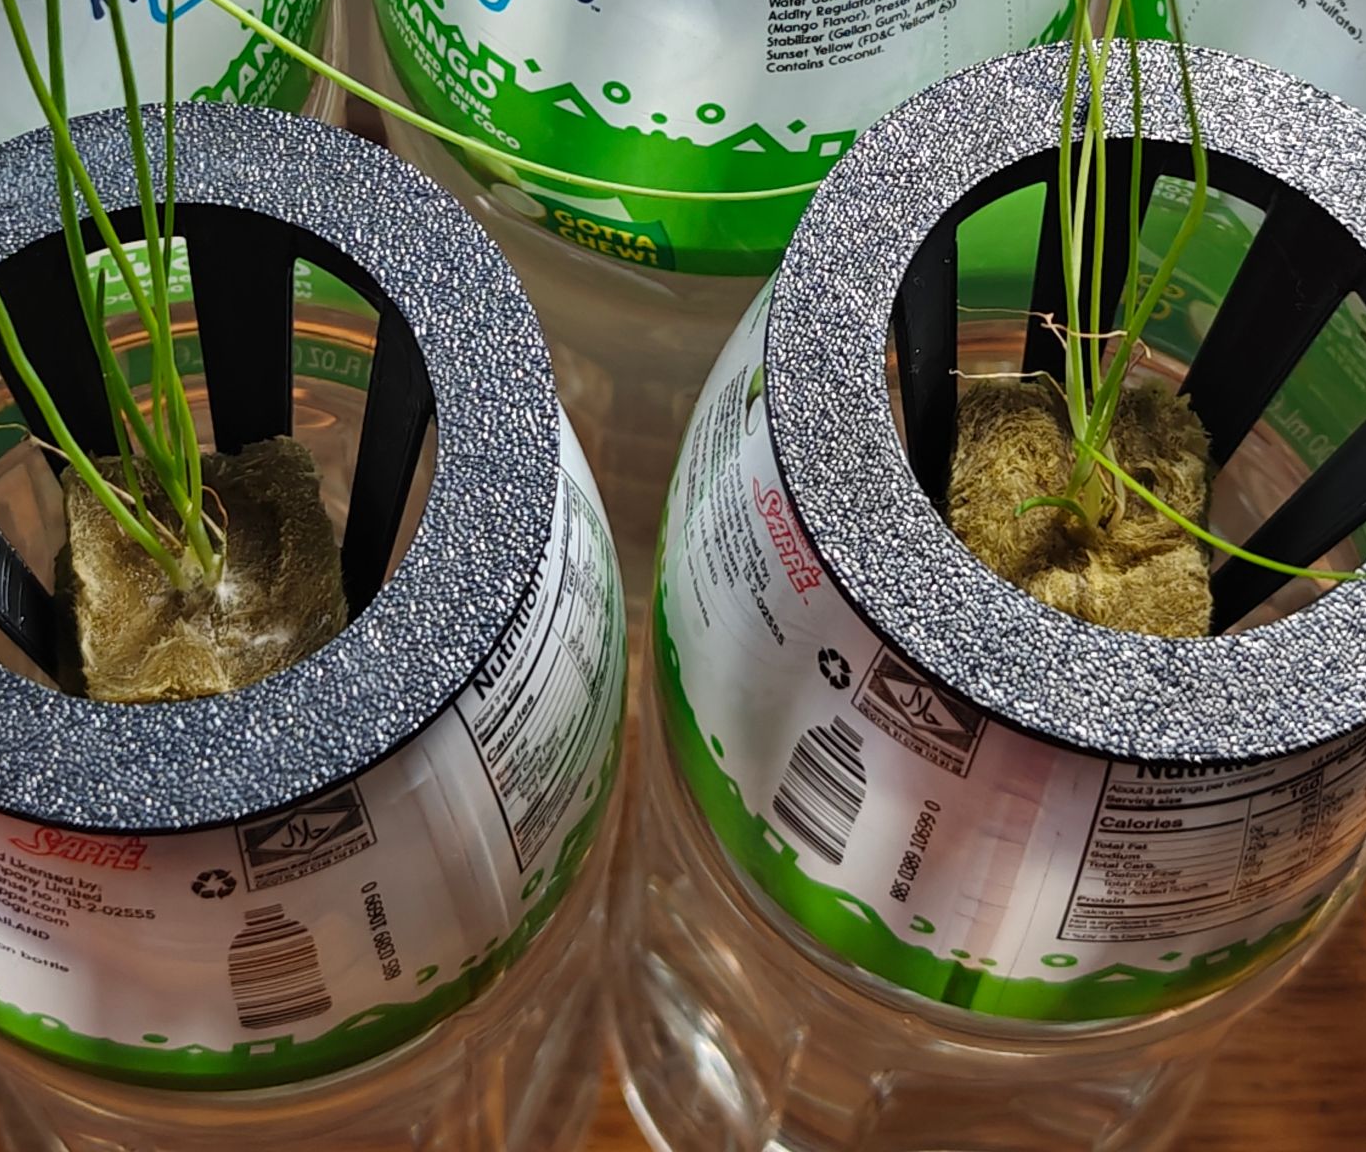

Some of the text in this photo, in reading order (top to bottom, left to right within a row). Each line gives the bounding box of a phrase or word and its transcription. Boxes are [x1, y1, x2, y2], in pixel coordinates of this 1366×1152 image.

[766, 49, 810, 61] Sunset
[813, 39, 854, 56] Yellow
[899, 11, 935, 32] Yellow
[767, 19, 819, 36] (Mango
[767, 33, 824, 47] Stabilizer
[766, 59, 824, 74] Contains
[445, 72, 492, 119] DRINK
[451, 93, 470, 115] DE
[473, 113, 521, 150] COCO
[554, 209, 658, 251] GOTTA
[1108, 784, 1144, 796] About
[1098, 816, 1184, 829] Calories
[889, 799, 942, 903] 885 0389 10699 0
[9, 855, 74, 886] Licensed
[45, 881, 103, 904] Limited
[361, 881, 378, 894] 0
[66, 897, 156, 920] 13-2-02555
[20, 950, 71, 974] bottle
